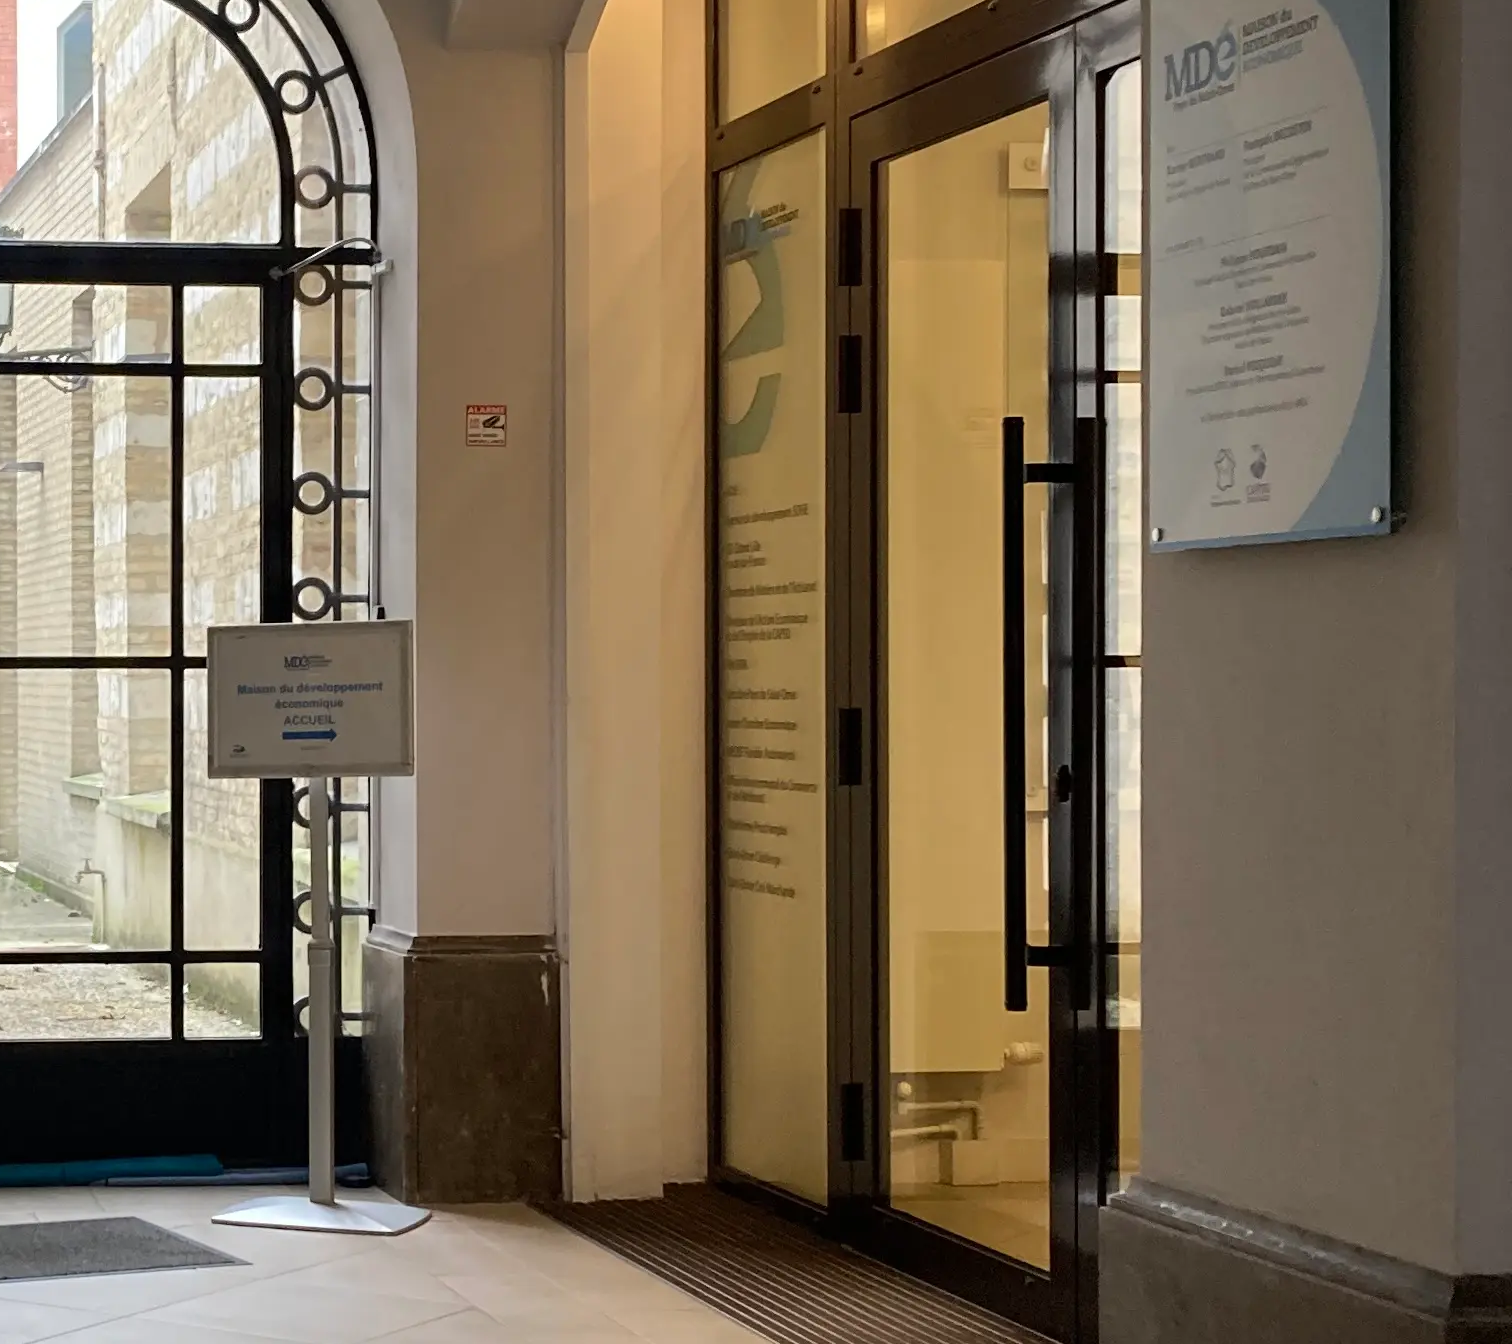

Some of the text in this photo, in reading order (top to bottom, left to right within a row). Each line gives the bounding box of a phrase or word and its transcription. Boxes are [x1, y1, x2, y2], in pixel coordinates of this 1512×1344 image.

[237, 681, 384, 696] Maison du développement
[274, 699, 344, 711] économique
[283, 714, 337, 727] ACCUEIL
